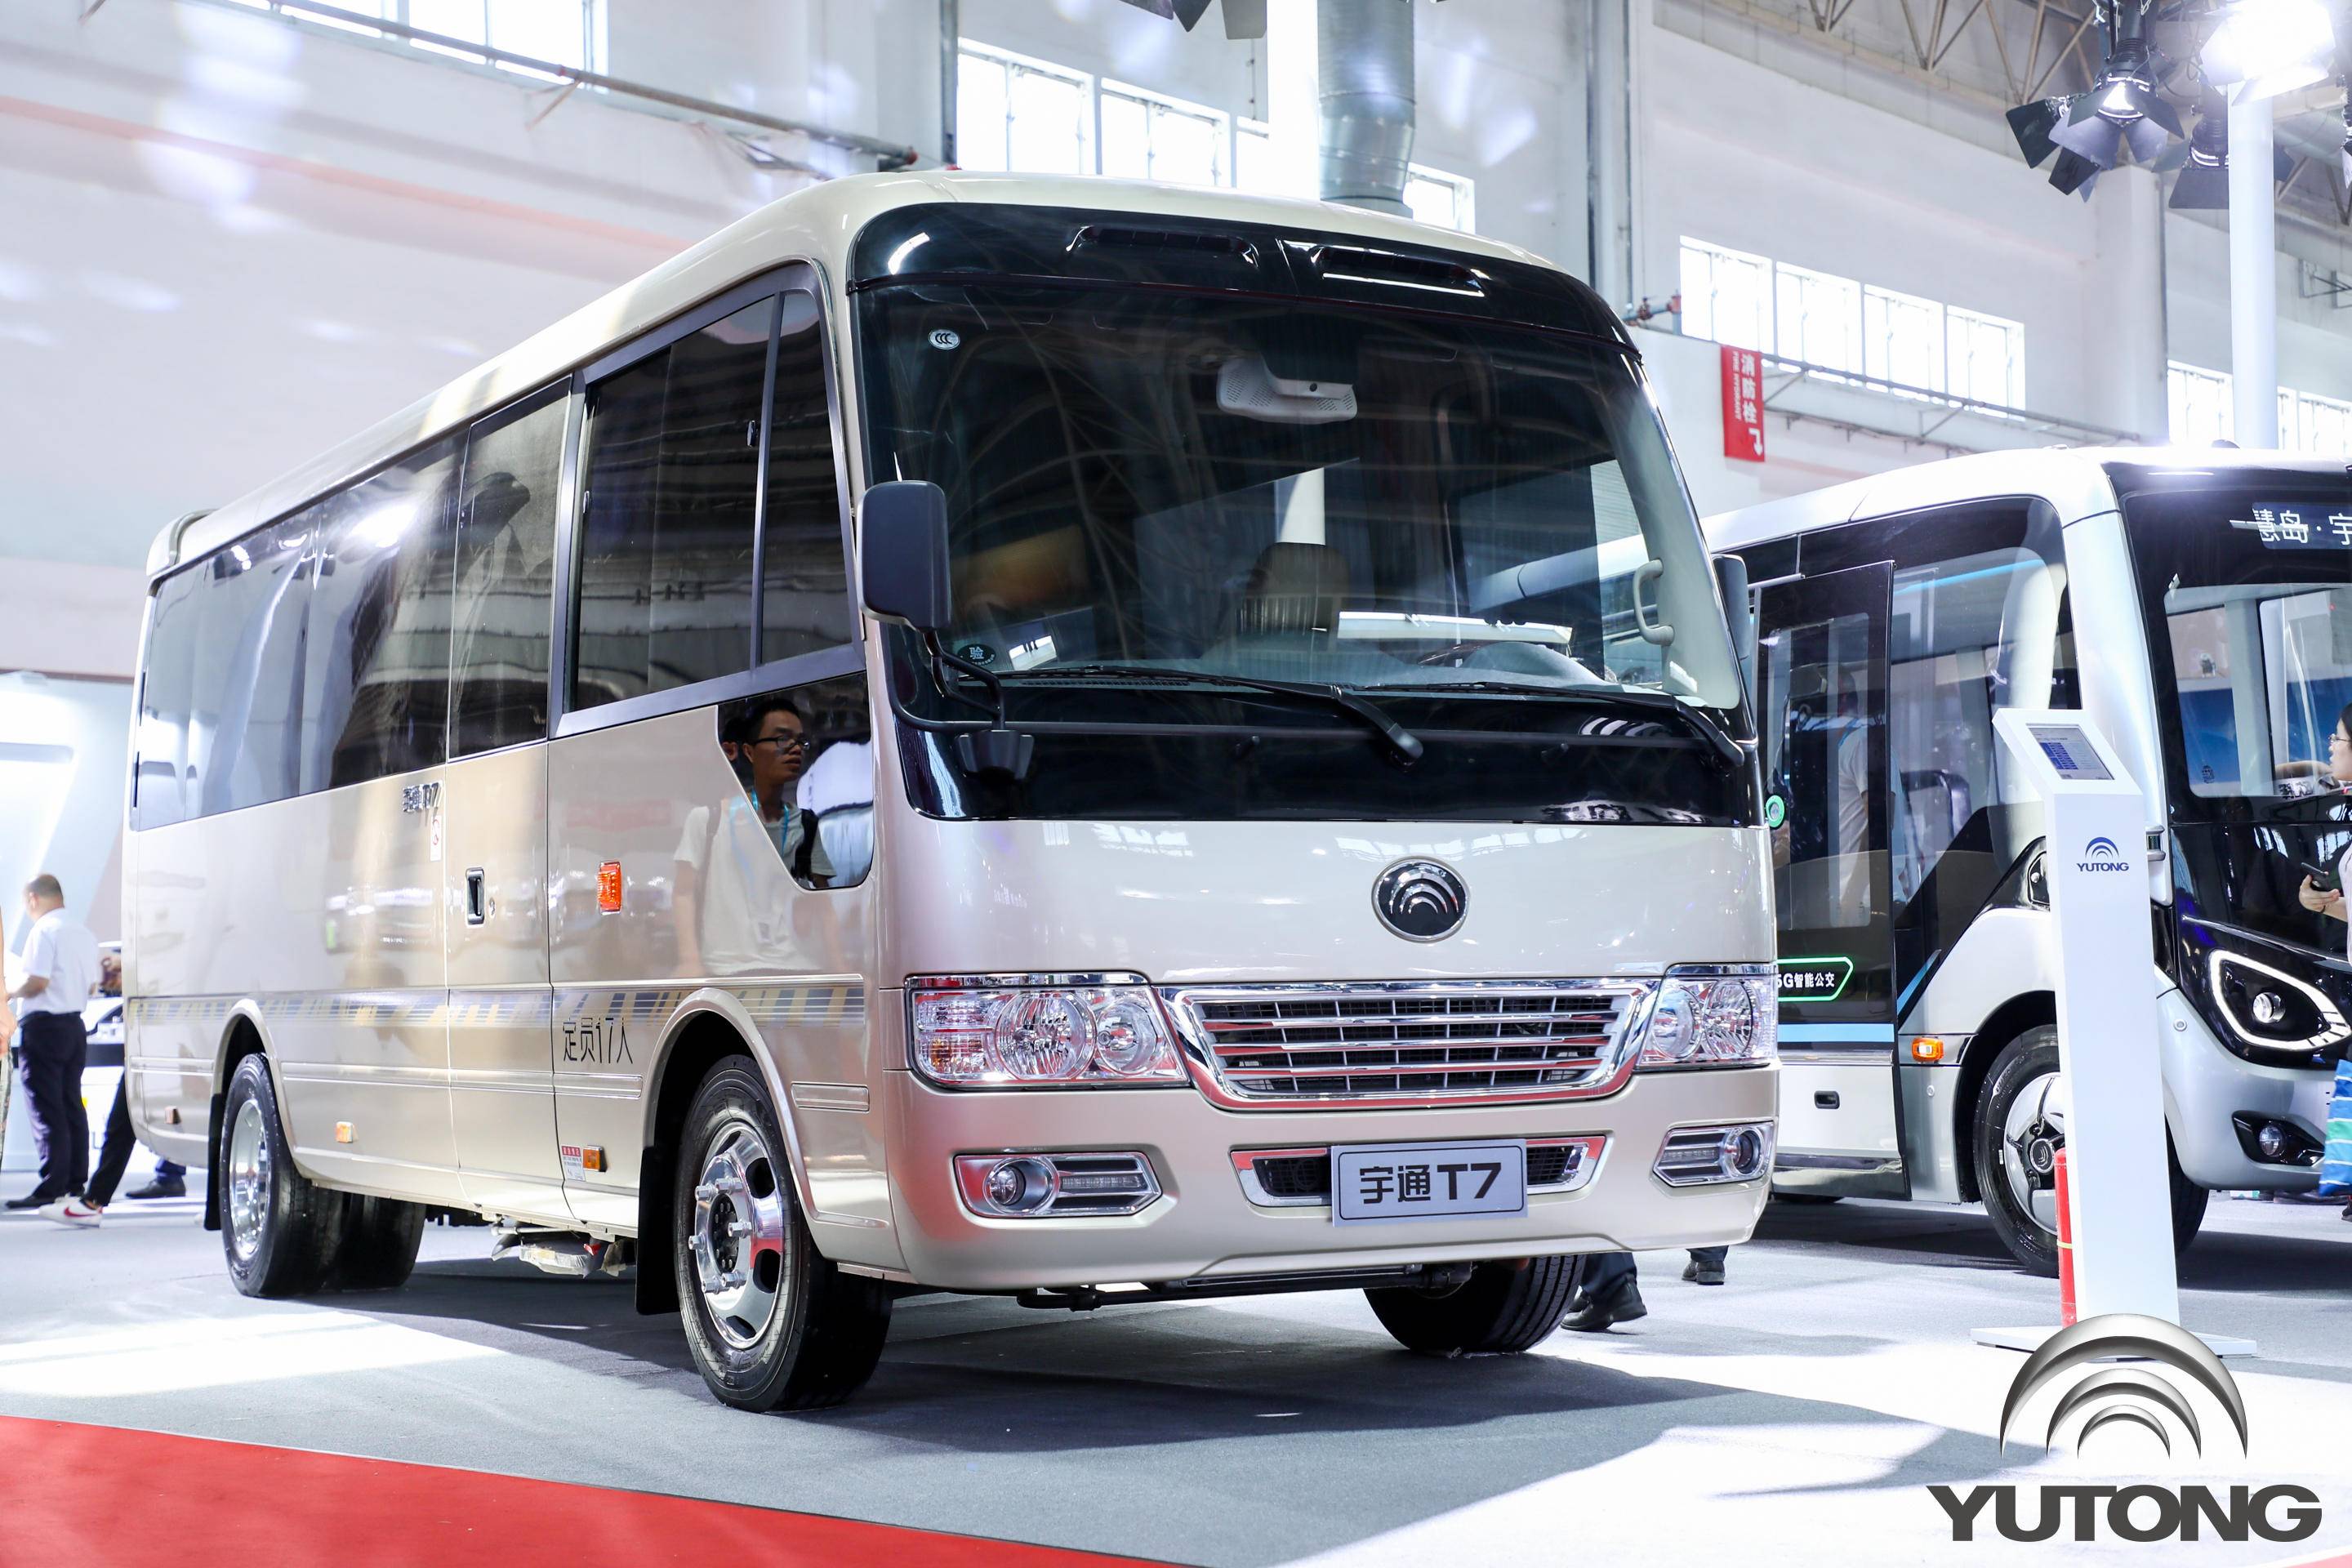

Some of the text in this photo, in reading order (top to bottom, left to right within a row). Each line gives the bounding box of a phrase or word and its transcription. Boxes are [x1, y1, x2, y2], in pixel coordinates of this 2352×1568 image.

[1741, 353, 1757, 424] 消防栓
[2077, 862, 2129, 871] YUTONG
[563, 1017, 633, 1064] 定员17人
[1360, 1162, 1502, 1204] 宇通T7
